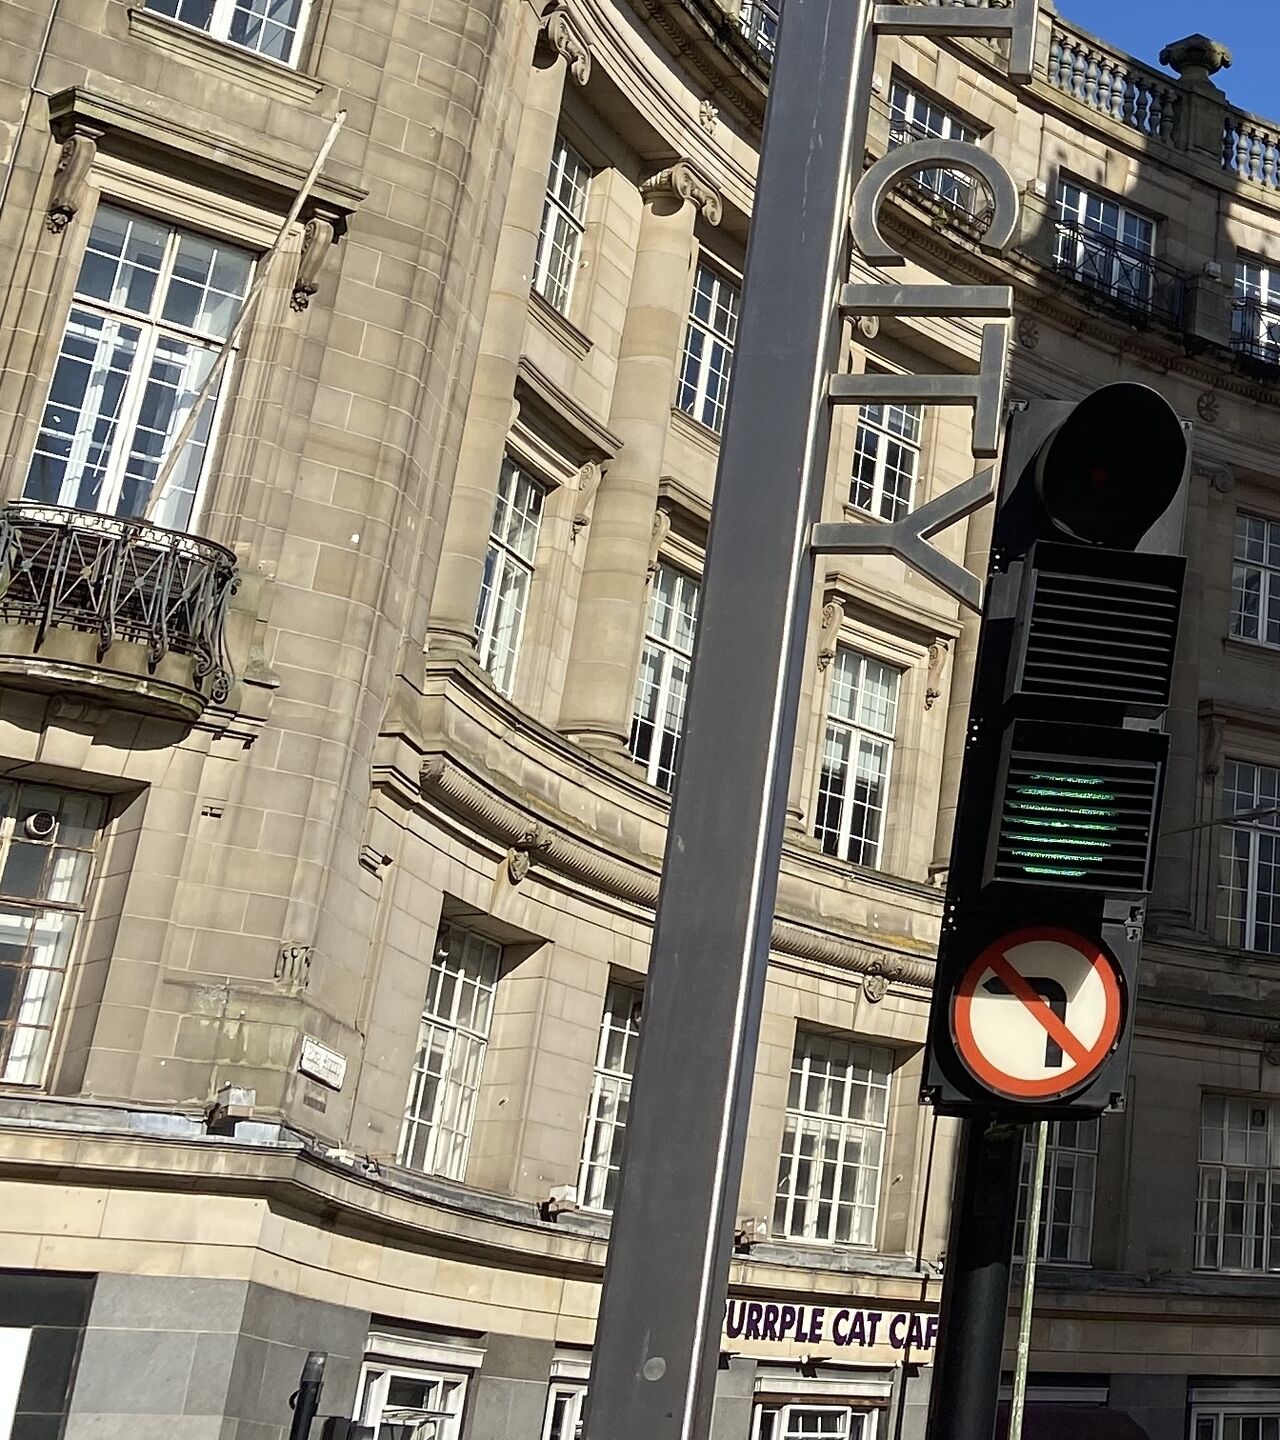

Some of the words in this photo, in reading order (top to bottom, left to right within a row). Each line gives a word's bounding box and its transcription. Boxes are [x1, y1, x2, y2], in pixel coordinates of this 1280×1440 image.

[811, 139, 1020, 613] CITY
[724, 1300, 825, 1344] URRPLE
[832, 1309, 882, 1347] CAT
[889, 1312, 939, 1350] CAF
